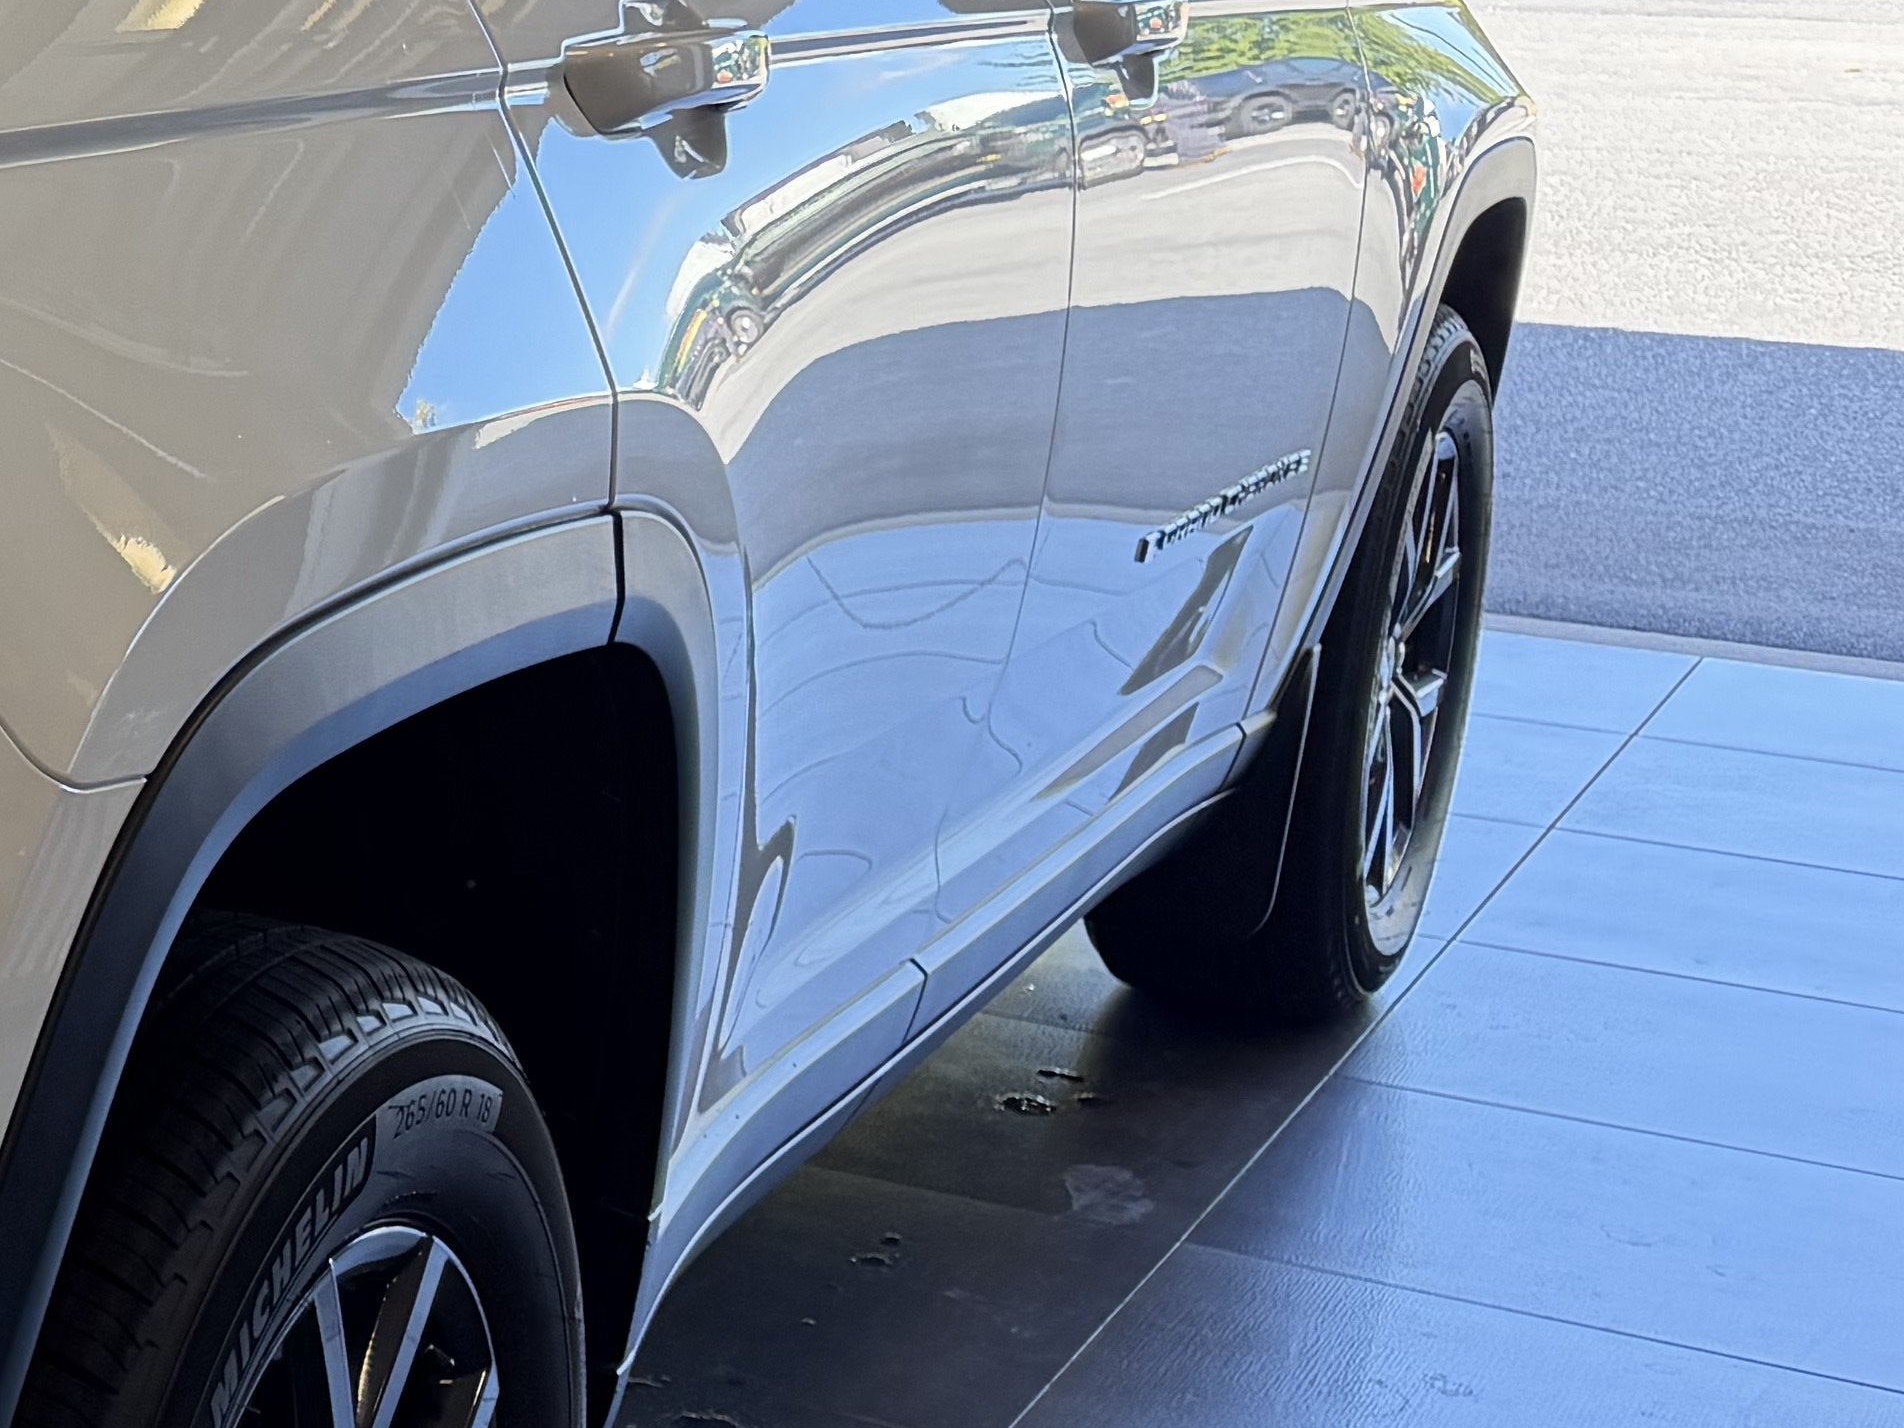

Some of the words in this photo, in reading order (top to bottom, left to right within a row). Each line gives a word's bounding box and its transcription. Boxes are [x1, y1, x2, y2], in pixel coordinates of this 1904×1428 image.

[393, 1087, 457, 1140] 265/60
[460, 1088, 473, 1118] R
[477, 1093, 493, 1123] 18
